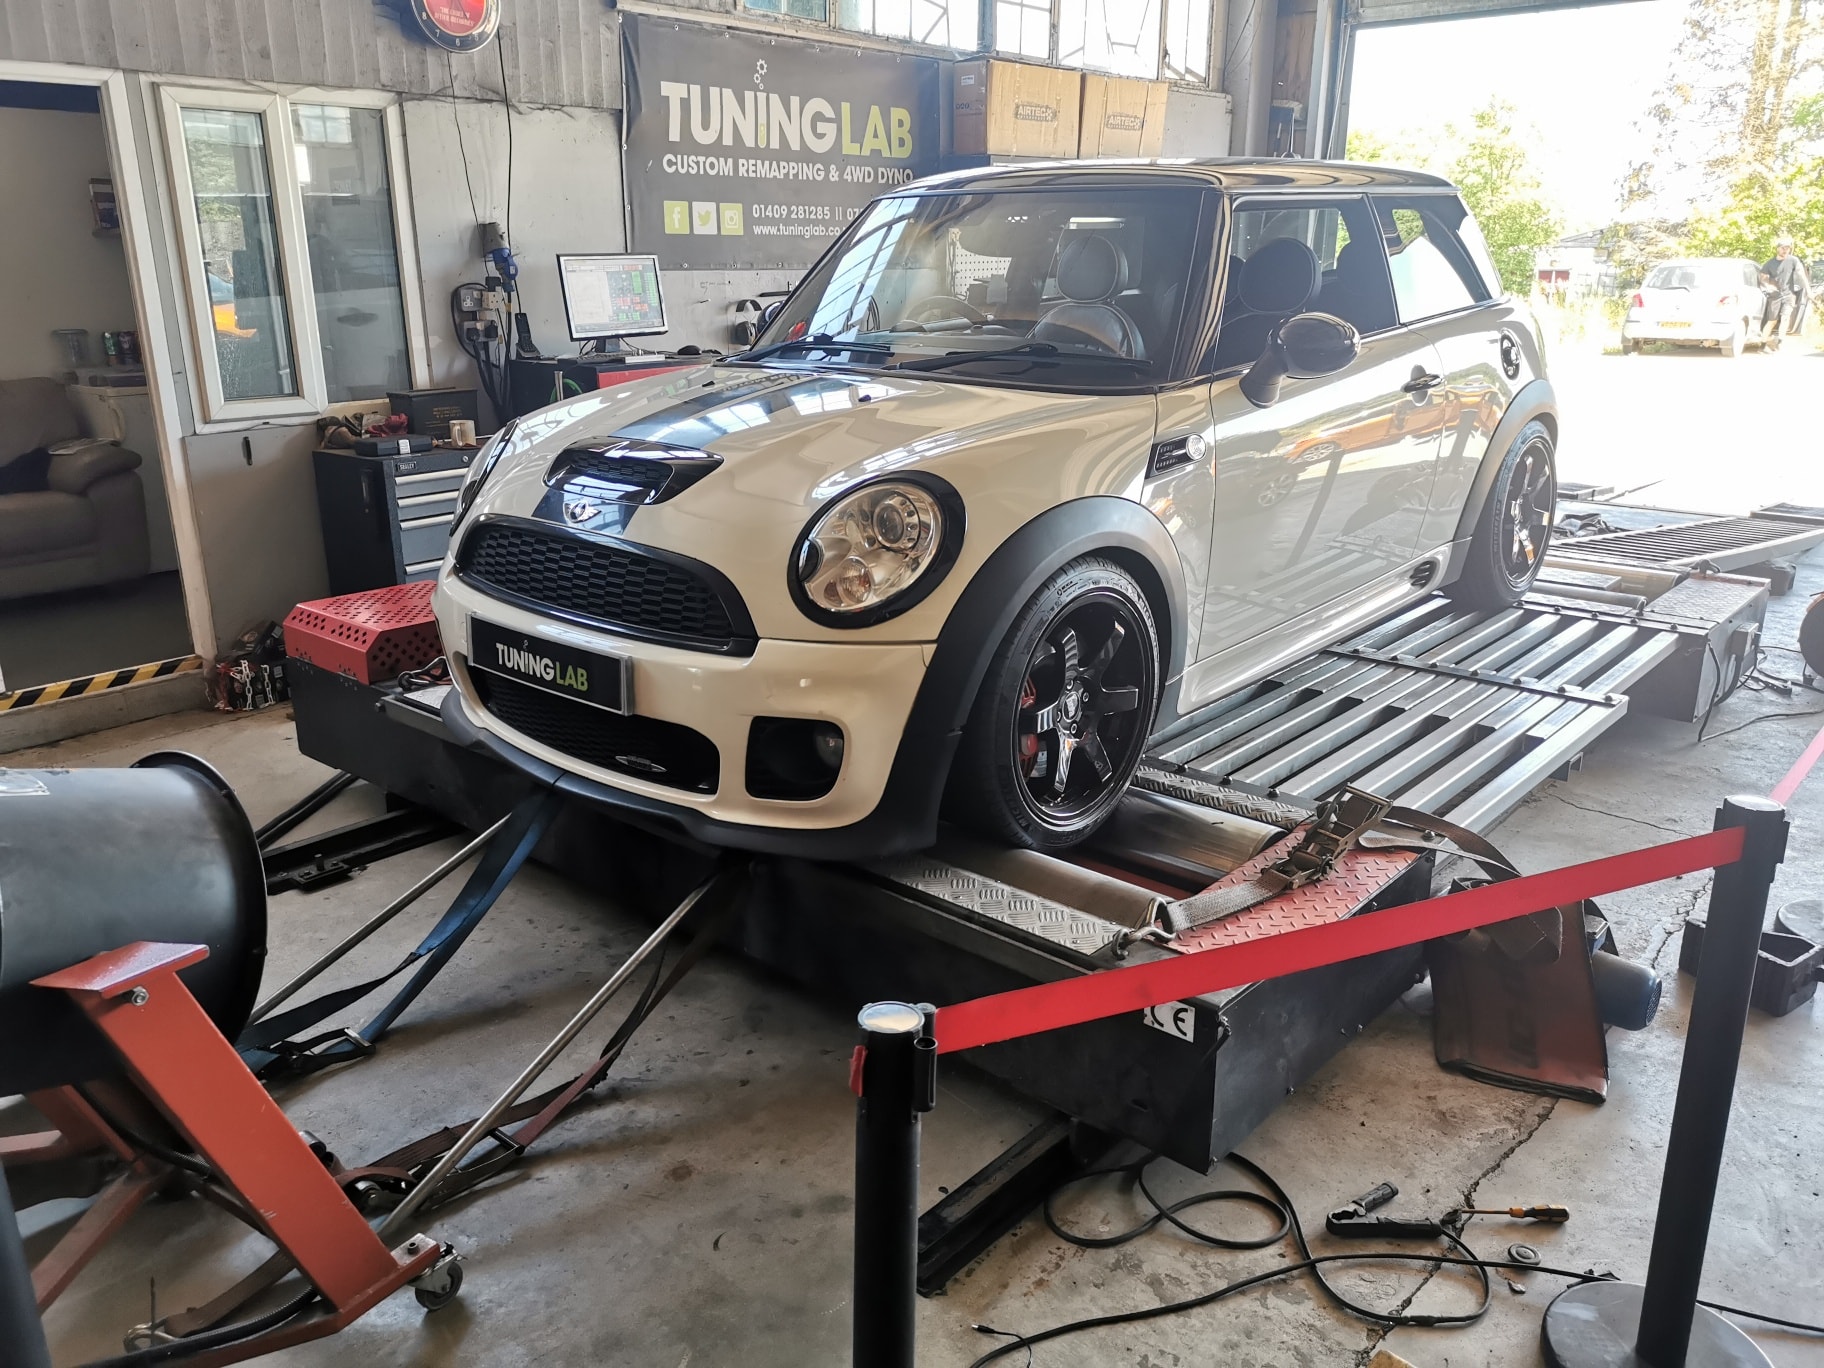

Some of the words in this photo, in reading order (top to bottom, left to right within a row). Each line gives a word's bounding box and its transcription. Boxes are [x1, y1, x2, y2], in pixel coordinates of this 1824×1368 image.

[662, 153, 733, 177] CUSTOM
[738, 159, 825, 181] REMAPPING
[829, 165, 839, 182] &
[843, 165, 874, 183] 4WD
[878, 167, 913, 184] DYNO
[752, 204, 787, 219] 01409
[790, 205, 830, 220] 281285
[495, 642, 589, 692] TUNINGLAB
